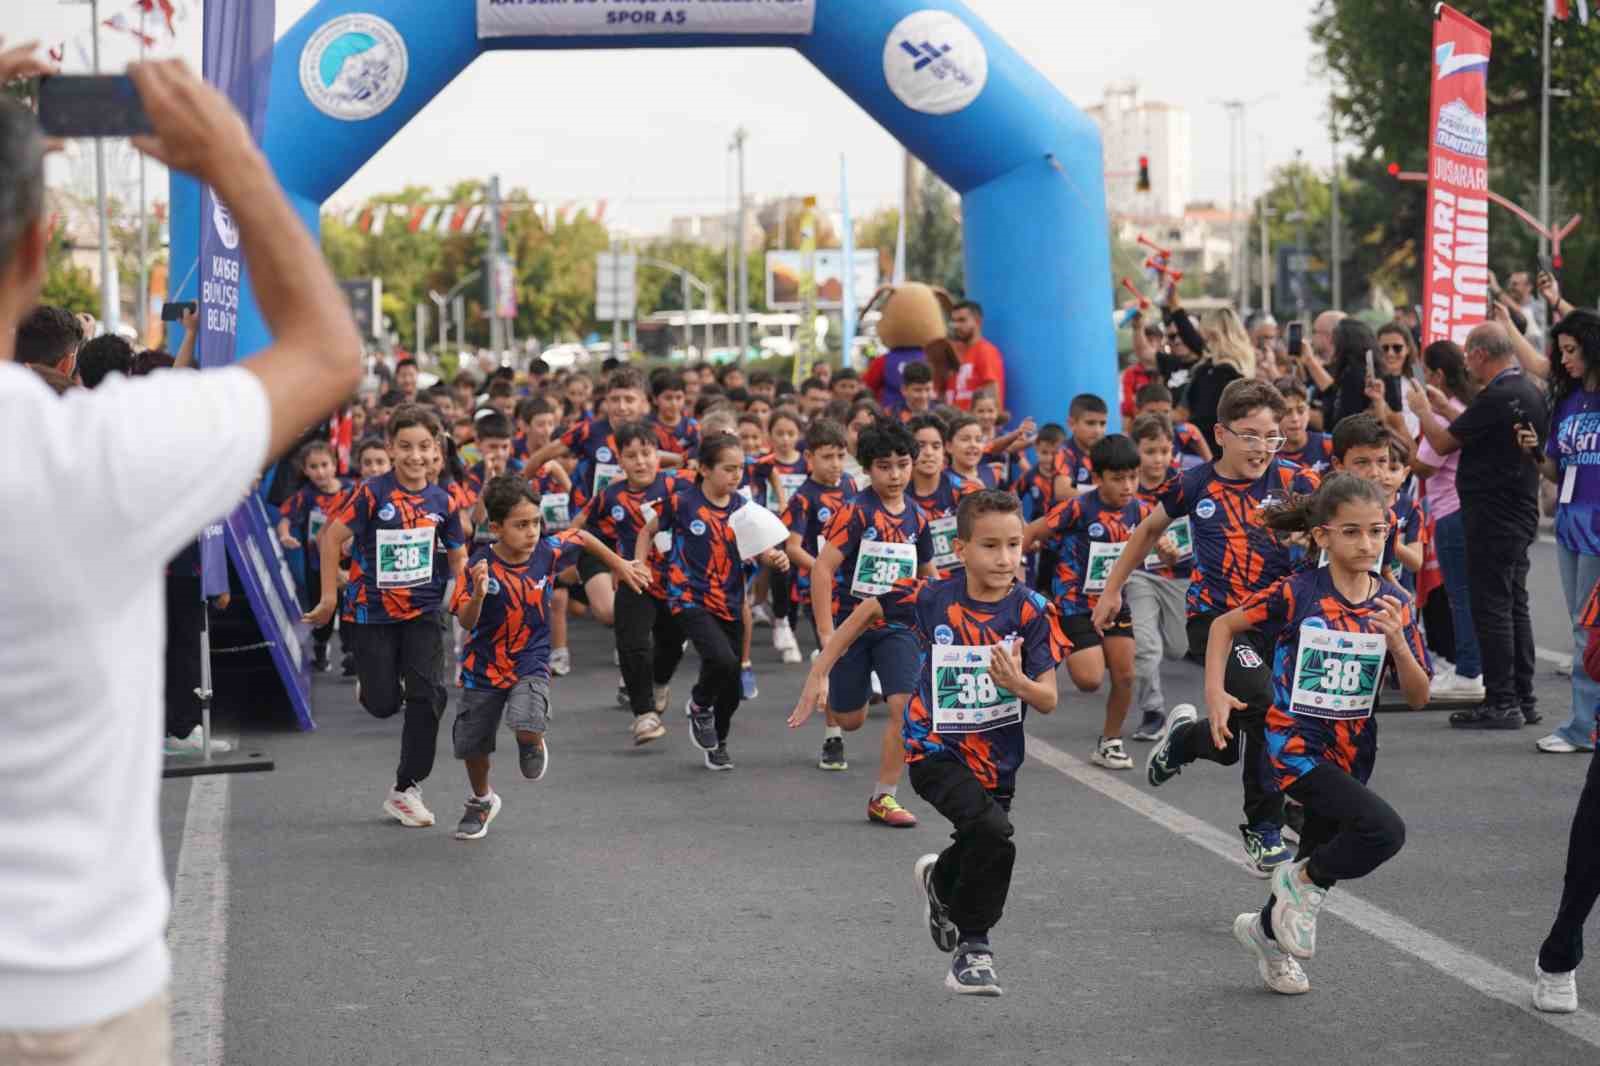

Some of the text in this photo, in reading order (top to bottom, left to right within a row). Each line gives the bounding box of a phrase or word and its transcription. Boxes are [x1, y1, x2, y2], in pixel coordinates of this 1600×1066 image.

[606, 10, 656, 24] SPOR
[1432, 187, 1456, 283] YARI
[393, 547, 420, 570] 38
[872, 560, 900, 585] 38
[956, 672, 998, 704] 38
[1320, 658, 1361, 692] 38
